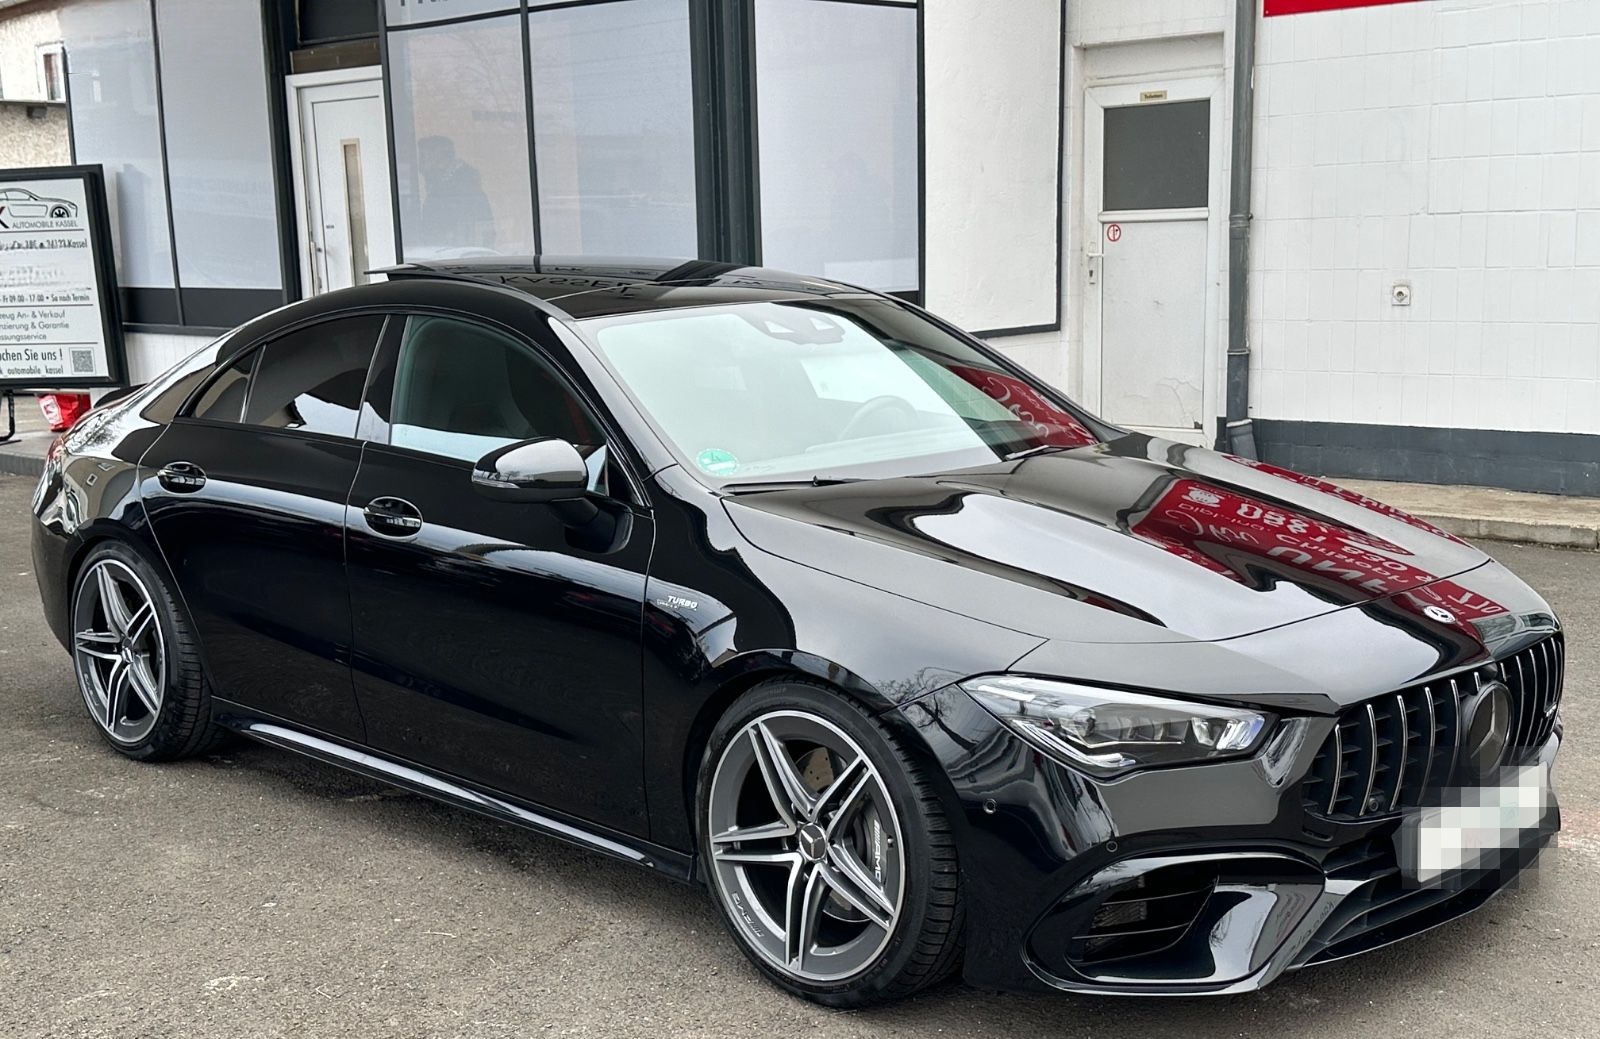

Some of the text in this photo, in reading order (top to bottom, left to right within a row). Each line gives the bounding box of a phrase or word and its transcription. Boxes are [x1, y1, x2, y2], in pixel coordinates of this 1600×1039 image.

[12, 220, 78, 229] AUTOMOBILE KASSEL
[68, 238, 88, 249] Kassel
[72, 293, 90, 301] Termin
[38, 309, 66, 319] Verkauf
[38, 321, 69, 329] Garantie
[24, 348, 38, 361] Sie
[41, 350, 57, 361] uns
[668, 595, 698, 609] TURBO
